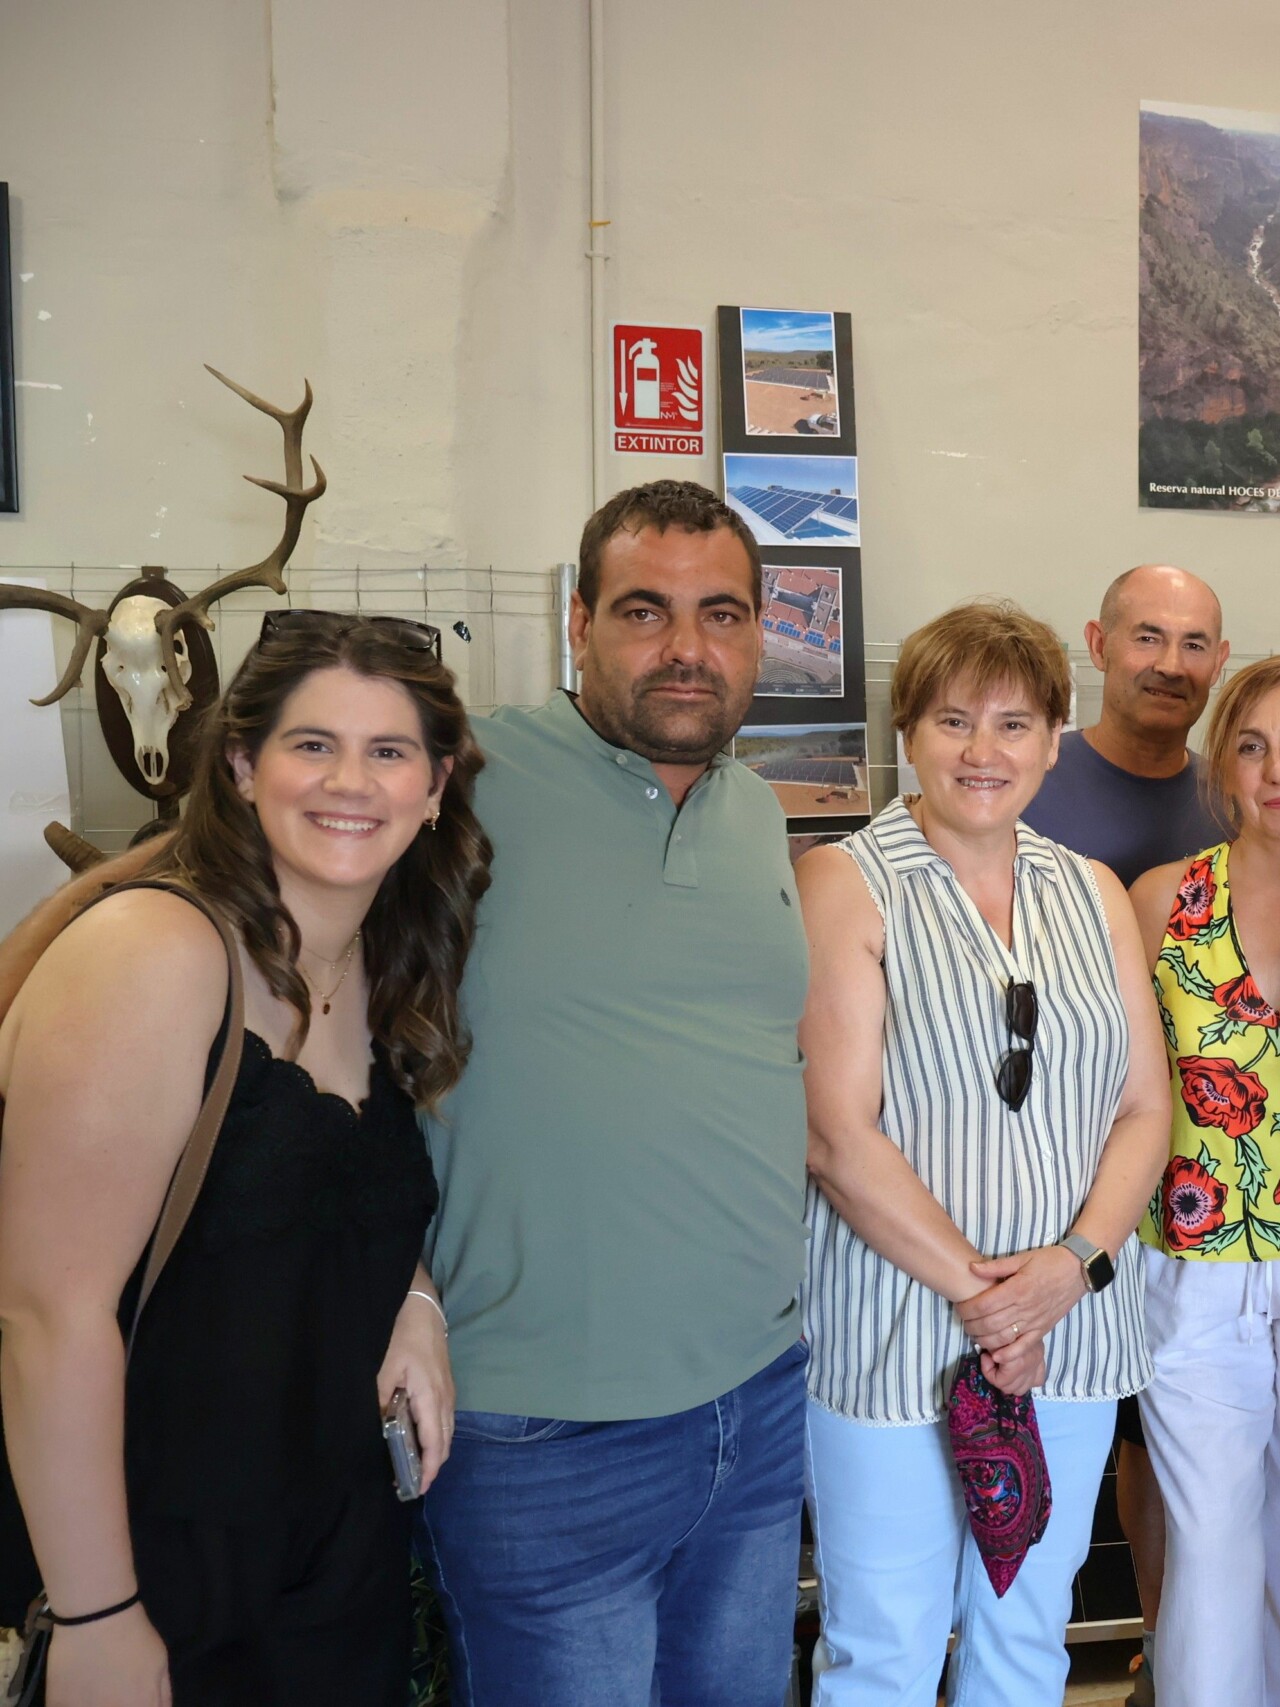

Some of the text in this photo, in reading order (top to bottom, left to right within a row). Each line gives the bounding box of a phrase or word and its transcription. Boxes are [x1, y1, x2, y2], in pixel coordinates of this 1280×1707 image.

[617, 435, 700, 452] EXTINTOR
[1149, 482, 1188, 494] Reserva
[1190, 484, 1226, 496] natural
[1228, 486, 1265, 498] HOCES
